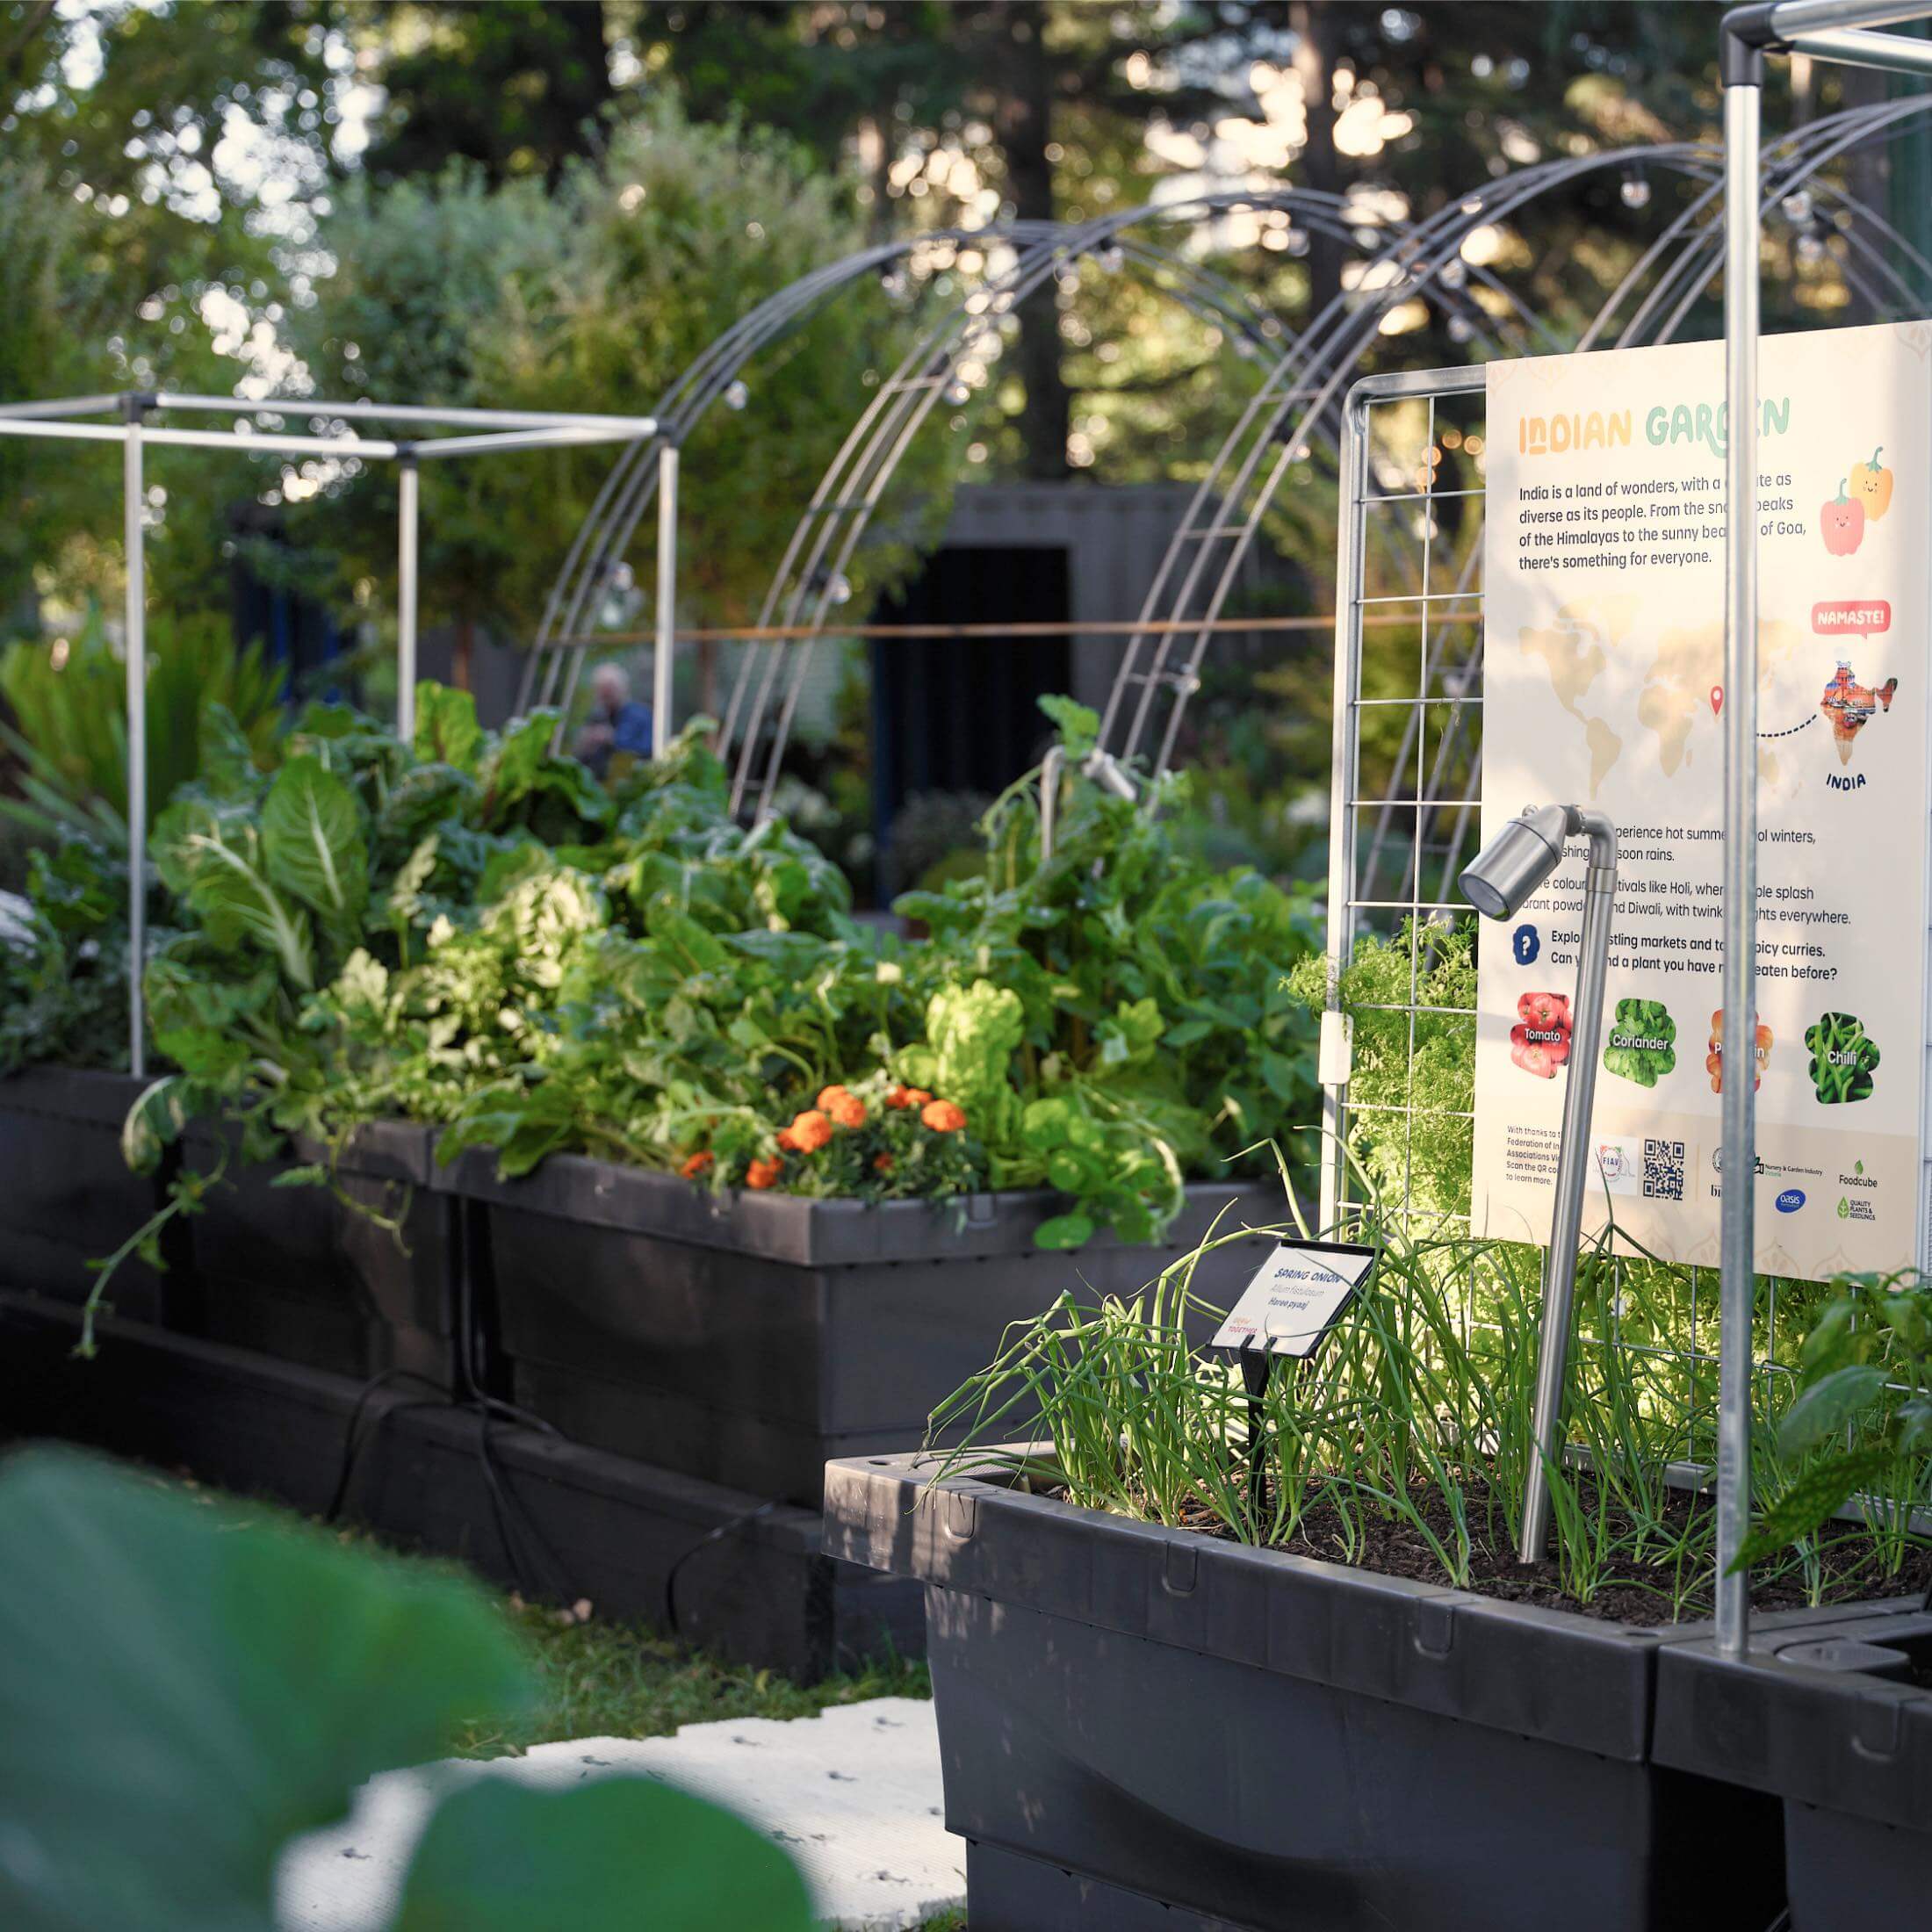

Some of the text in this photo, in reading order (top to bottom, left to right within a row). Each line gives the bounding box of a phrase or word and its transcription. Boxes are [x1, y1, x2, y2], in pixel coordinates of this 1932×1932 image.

[1519, 486, 1549, 501] India
[1552, 485, 1561, 499] is
[1565, 487, 1572, 498] a
[1575, 483, 1602, 497] land
[1605, 481, 1618, 496] of
[1621, 480, 1678, 495] wonders,
[1681, 477, 1709, 492] with
[1712, 479, 1720, 490] a
[1776, 474, 1791, 486] as
[1519, 510, 1563, 523] diverse
[1566, 510, 1581, 522] as
[1584, 507, 1598, 520] its
[1602, 505, 1647, 523] people.
[1650, 504, 1680, 516] From
[1683, 501, 1705, 515] the
[1519, 533, 1531, 547] of
[1534, 533, 1553, 546] the
[1557, 530, 1620, 546] Himalayas
[1623, 529, 1635, 542] to
[1639, 528, 1658, 541] the
[1662, 527, 1699, 542] sunny
[1760, 521, 1773, 536] of
[1777, 521, 1806, 535] Goa,
[1519, 551, 1712, 570] there's something for everyone.
[1817, 610, 1884, 625] NAMASTE!
[1826, 773, 1867, 791] INDIA
[1666, 827, 1684, 840] hot
[1770, 829, 1816, 844] winters,
[1646, 848, 1675, 861] rains.
[1649, 880, 1667, 894] like
[1670, 882, 1693, 896] Holi,
[1776, 886, 1814, 901] splash
[1628, 902, 1663, 917] Diwali,
[1666, 904, 1690, 916] with
[1779, 910, 1851, 925] everywhere.
[1641, 935, 1687, 949] markets
[1690, 938, 1712, 951] and
[1782, 943, 1826, 957] curries.
[1551, 952, 1572, 964] Can
[1622, 958, 1629, 968] a
[1632, 956, 1661, 971] plant
[1664, 960, 1684, 973] you
[1687, 959, 1716, 973] have
[1791, 966, 1838, 980] before?
[1525, 1028, 1561, 1042] Tomato
[1613, 1034, 1669, 1050] Coriander
[1827, 1050, 1857, 1065] Chilli
[1507, 1125, 1523, 1135] With
[1525, 1127, 1548, 1137] thanks
[1507, 1137, 1543, 1148] Federation
[1507, 1149, 1550, 1161] Associations
[1603, 1157, 1619, 1166] FIAV
[1506, 1161, 1523, 1170] Scan
[1525, 1163, 1536, 1171] the
[1537, 1164, 1547, 1172] QR
[1805, 1168, 1823, 1176] Industry
[1514, 1173, 1532, 1183] learn
[1533, 1177, 1553, 1186] more.
[1839, 1174, 1878, 1188] Foodcube
[1780, 1194, 1800, 1204] oasis
[1849, 1212, 1876, 1221] SEEDLINGS
[1274, 1268, 1341, 1283] SPRING ONION
